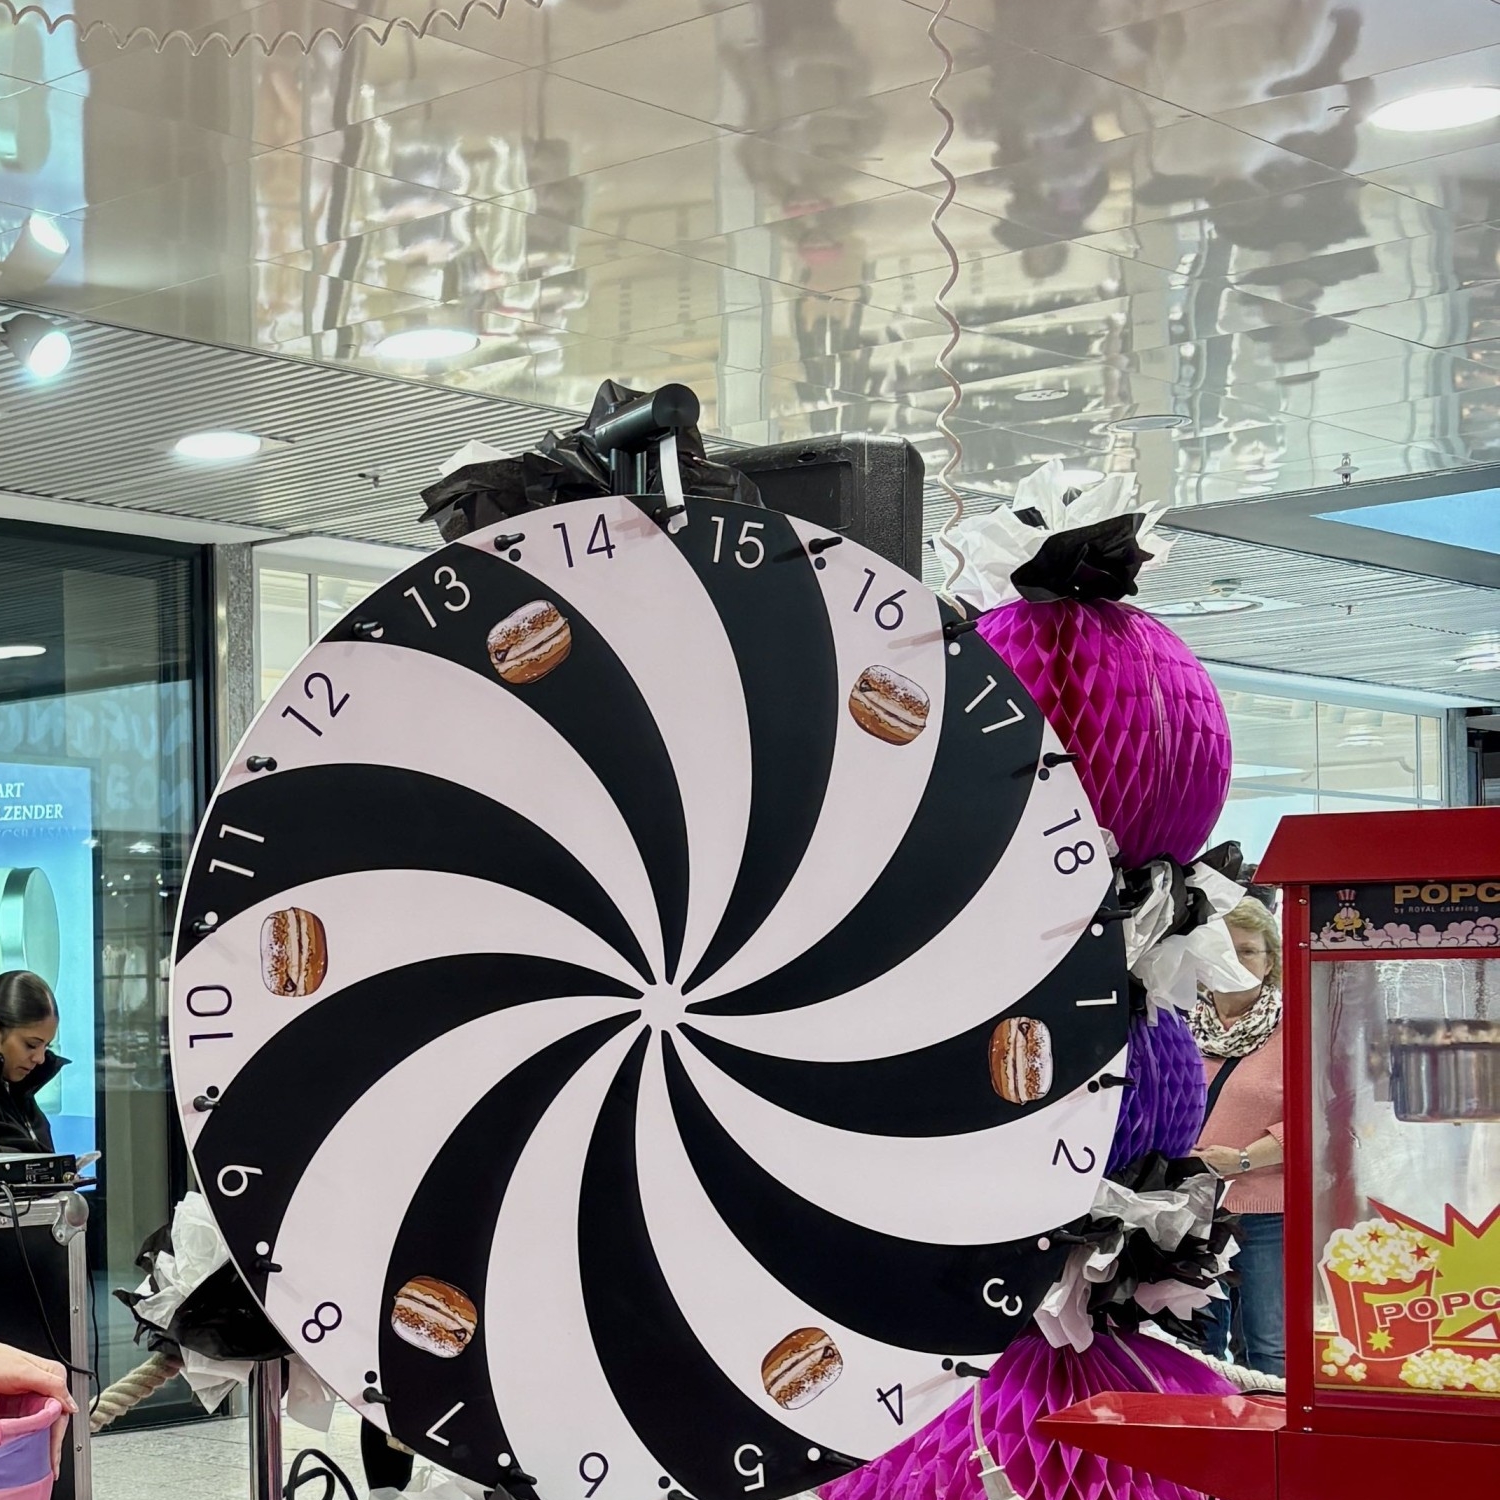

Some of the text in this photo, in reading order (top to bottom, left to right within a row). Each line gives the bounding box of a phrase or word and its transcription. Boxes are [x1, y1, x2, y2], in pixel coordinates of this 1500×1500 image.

[553, 513, 616, 568] 14
[710, 516, 765, 569] 15
[403, 565, 471, 629] 13
[852, 567, 908, 631] 16
[281, 671, 351, 737] 12
[964, 674, 1026, 734] 17
[208, 823, 266, 878] 11
[1042, 808, 1096, 875] 18
[1408, 905, 1437, 913] ROYAL
[186, 984, 234, 1049] 10
[1076, 990, 1118, 1006] 1
[216, 1164, 263, 1197] 9
[1052, 1138, 1096, 1174] 2
[301, 1301, 343, 1344] 8
[982, 1277, 1023, 1317] 3
[425, 1401, 465, 1447] 7
[876, 1382, 904, 1426] 4
[579, 1451, 610, 1499] 6
[733, 1442, 766, 1493] 5
